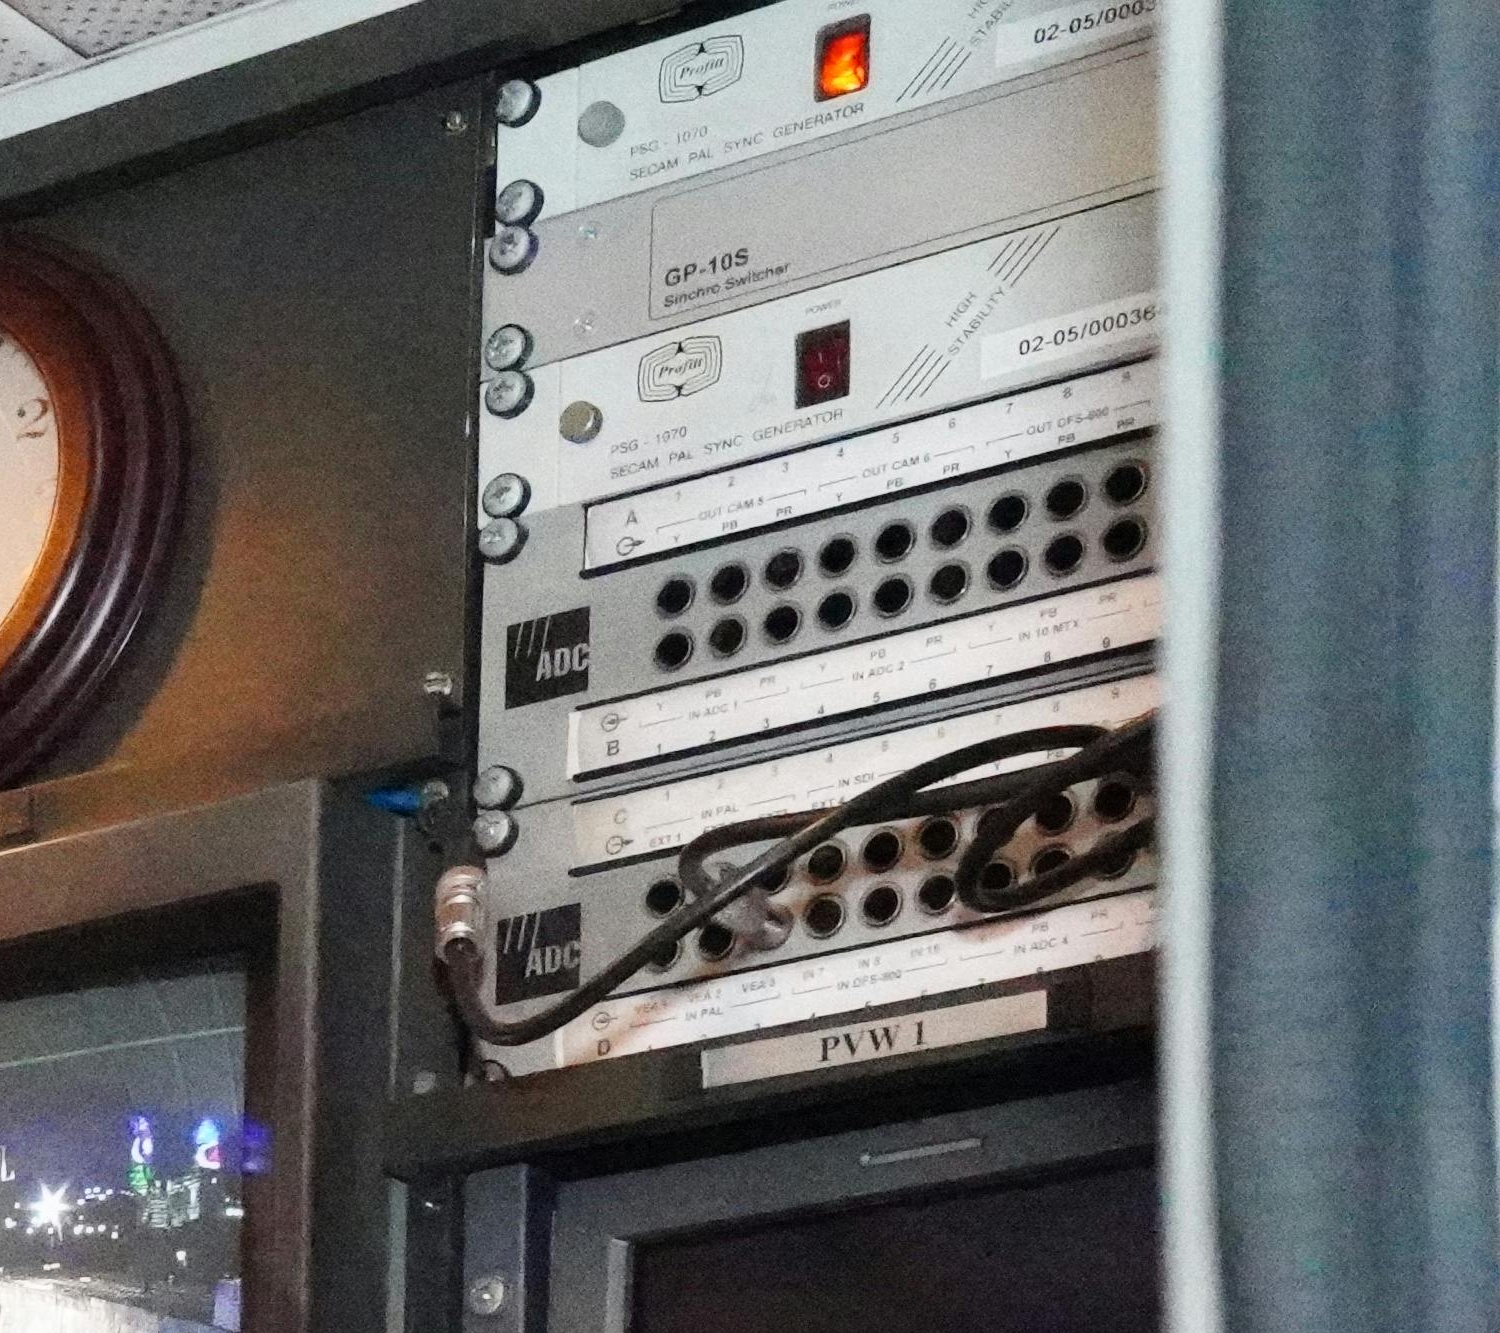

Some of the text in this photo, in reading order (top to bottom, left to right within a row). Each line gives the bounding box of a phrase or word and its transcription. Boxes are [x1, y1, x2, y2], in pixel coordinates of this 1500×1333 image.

[629, 102, 865, 181] SECAM PAL SYNC GENERATOR
[664, 248, 750, 287] GP-10S
[663, 282, 722, 308] Sinchro
[944, 291, 978, 328] HIGH
[949, 286, 1007, 355] STABILITY
[1018, 304, 1158, 357] 02-05/00036
[16, 397, 49, 441] 2
[1026, 421, 1053, 436] OUT
[609, 408, 844, 480] SECAM PAL SYNC GENERATOR
[610, 438, 640, 457] PSG
[862, 456, 920, 478] OUT CAM
[626, 510, 638, 525] A
[727, 499, 754, 514] CAM
[775, 505, 793, 518] PR
[925, 635, 943, 648] PR
[1018, 631, 1031, 642] IN
[536, 642, 589, 682] ADC
[852, 663, 894, 681] IN ADC
[606, 740, 619, 756] B
[838, 778, 850, 789] IN
[701, 803, 740, 820] IN PAL
[650, 835, 675, 849] EXT
[1013, 937, 1057, 957] IN ADC
[525, 939, 580, 978] ADC
[685, 1004, 724, 1021] IN PAL
[597, 1038, 610, 1056] D
[819, 1020, 926, 1062] PVW 1
